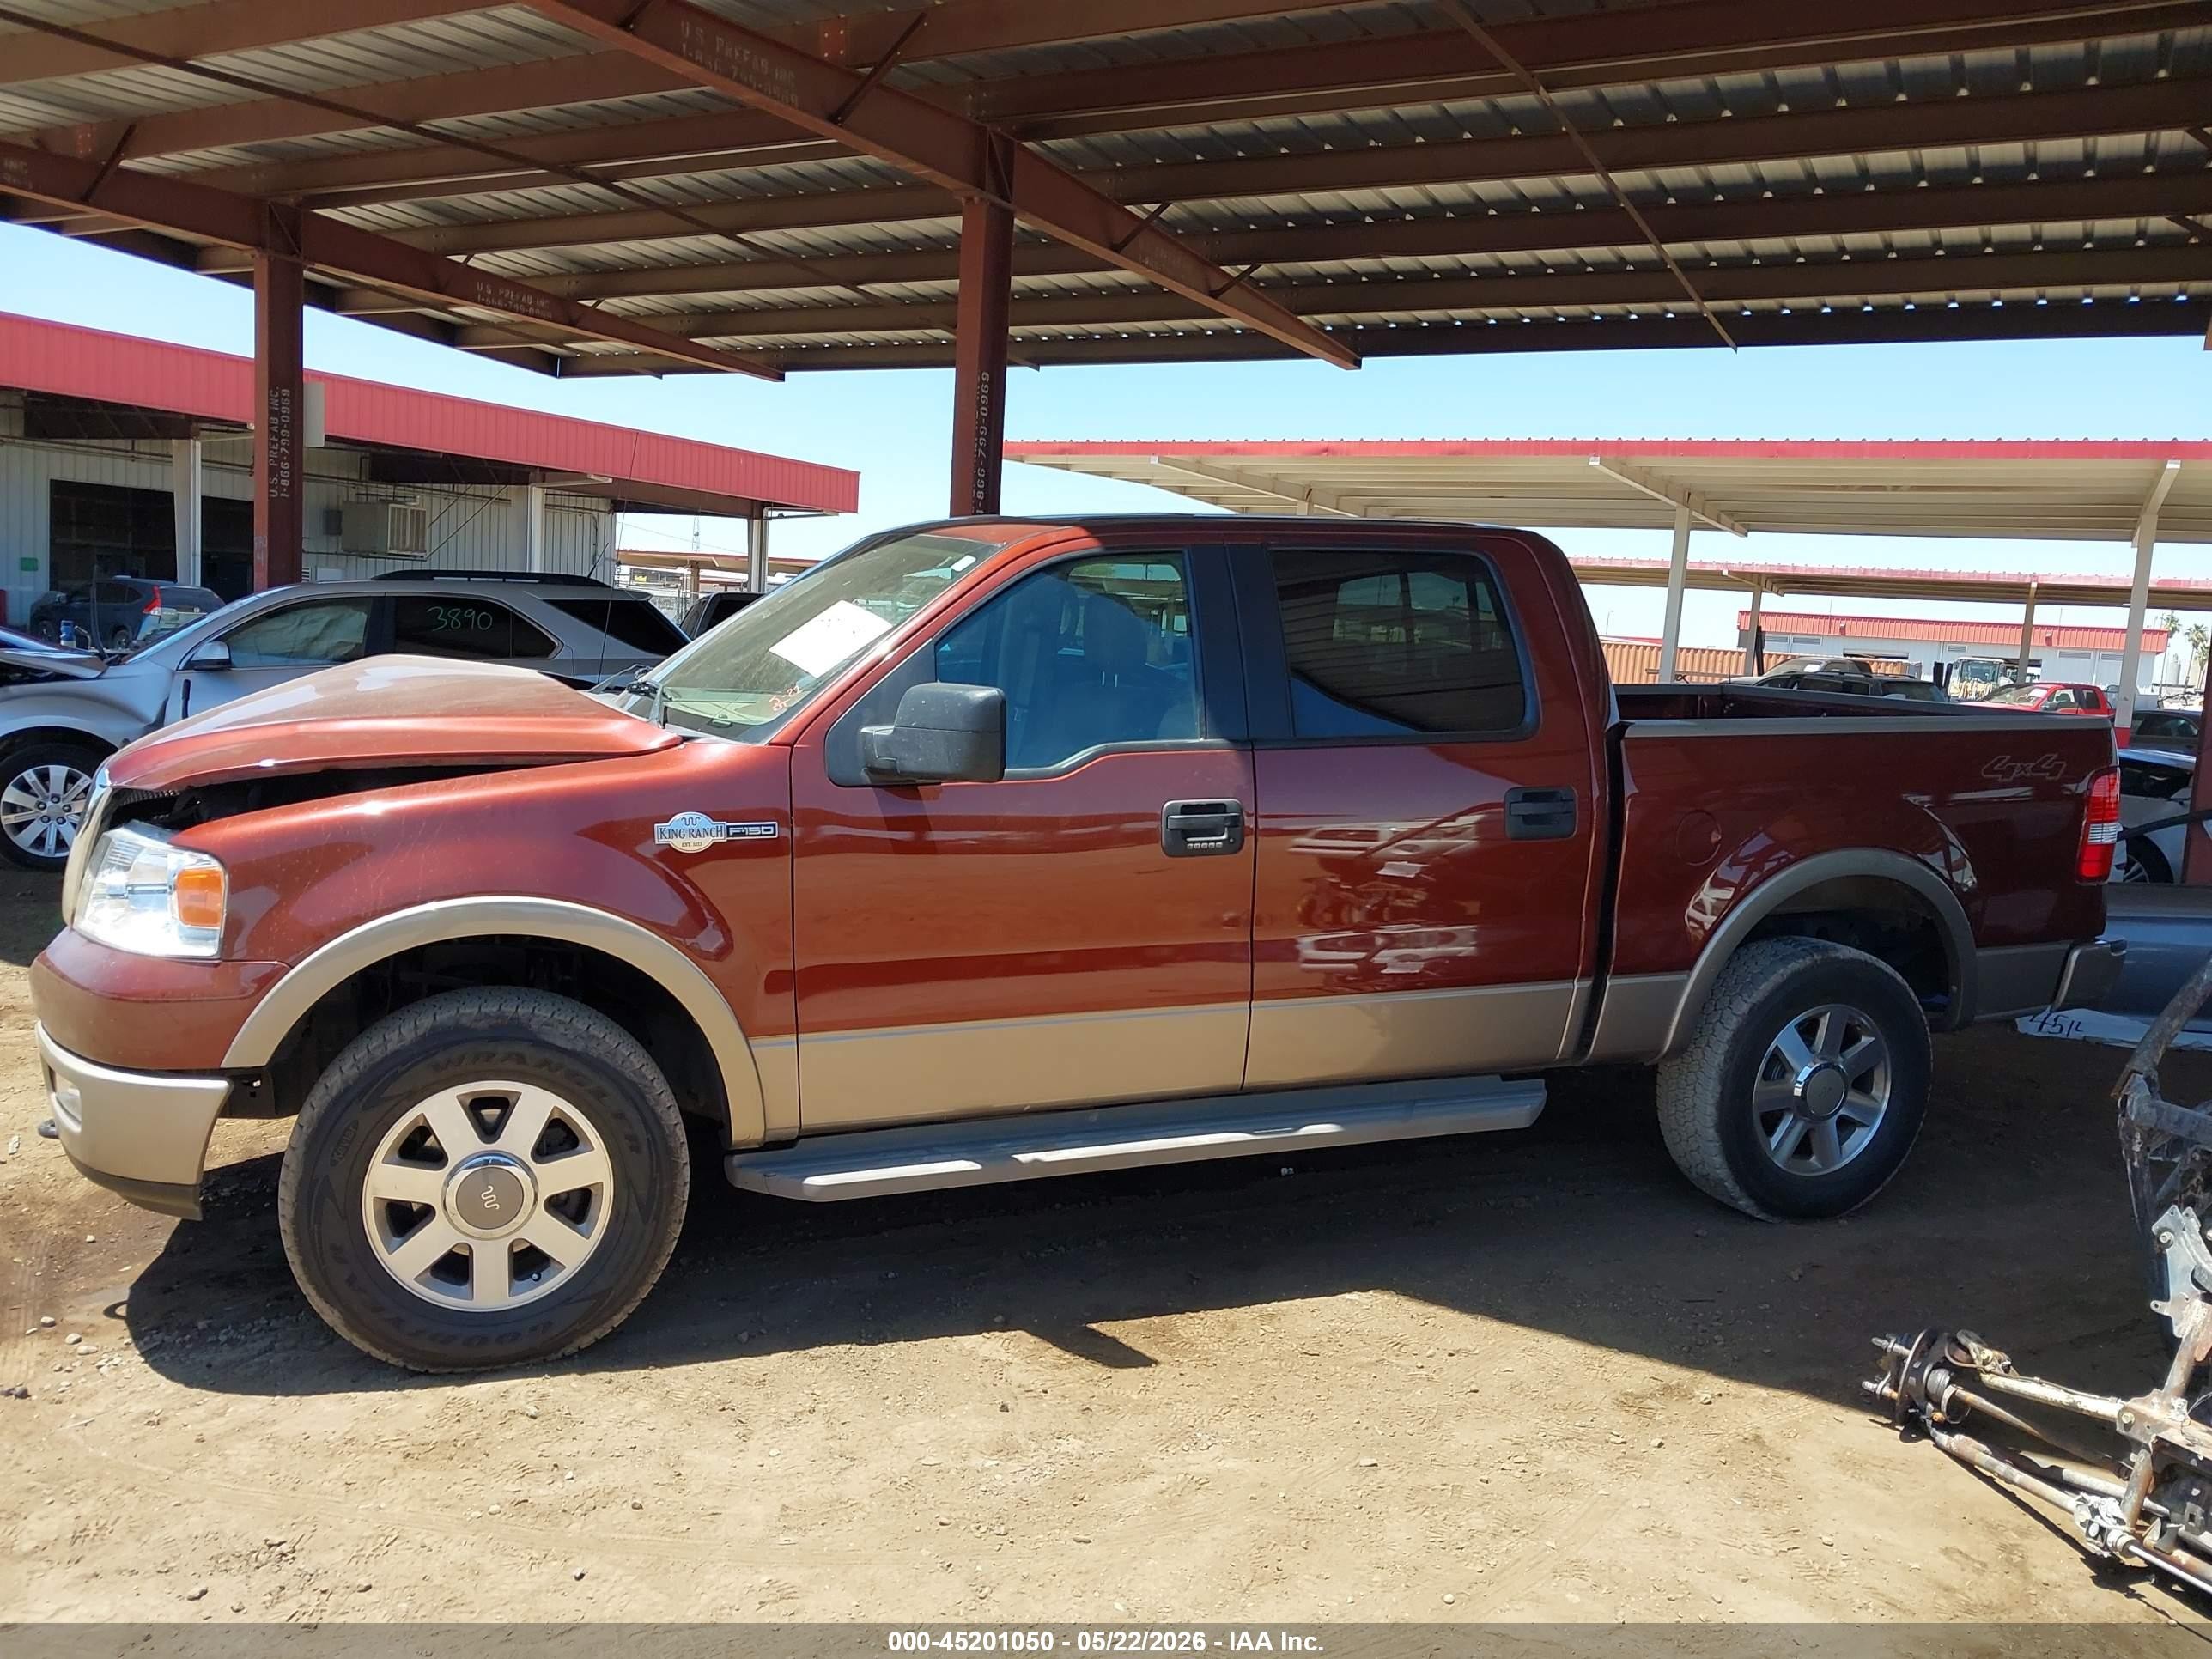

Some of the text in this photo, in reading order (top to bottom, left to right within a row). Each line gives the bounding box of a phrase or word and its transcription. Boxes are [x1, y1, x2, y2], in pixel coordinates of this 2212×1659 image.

[268, 416, 279, 466] PREFAB
[280, 388, 290, 497] 1-866-799-0969
[975, 371, 990, 514] 1-866-799-0969
[426, 606, 493, 632] 3890
[1981, 754, 2067, 781] 4x4
[659, 825, 724, 840] KING RANCH
